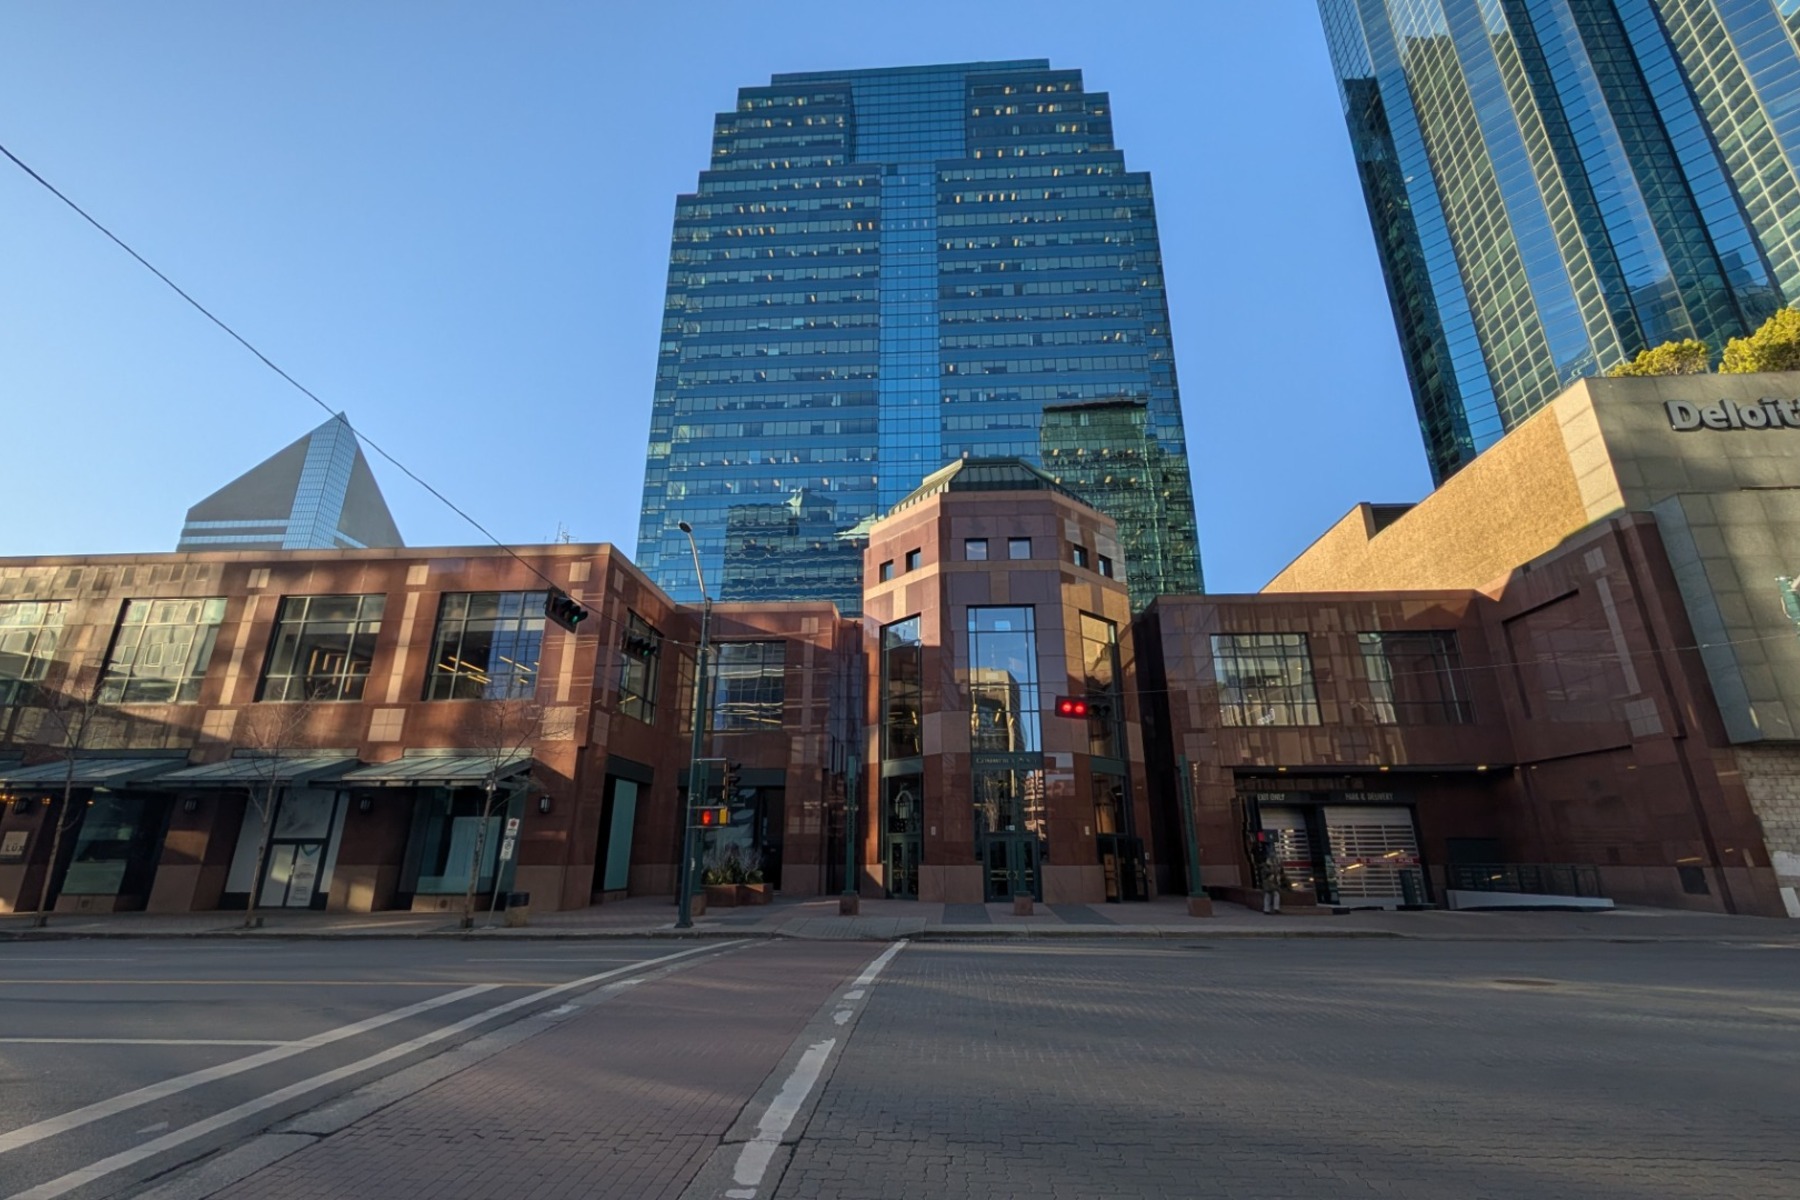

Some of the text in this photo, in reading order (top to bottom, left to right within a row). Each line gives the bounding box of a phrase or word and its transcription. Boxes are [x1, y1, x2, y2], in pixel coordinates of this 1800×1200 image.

[1664, 397, 1800, 431] Deloit
[1257, 793, 1285, 801] EXIT ONLY
[1367, 792, 1394, 801] DELIVERY
